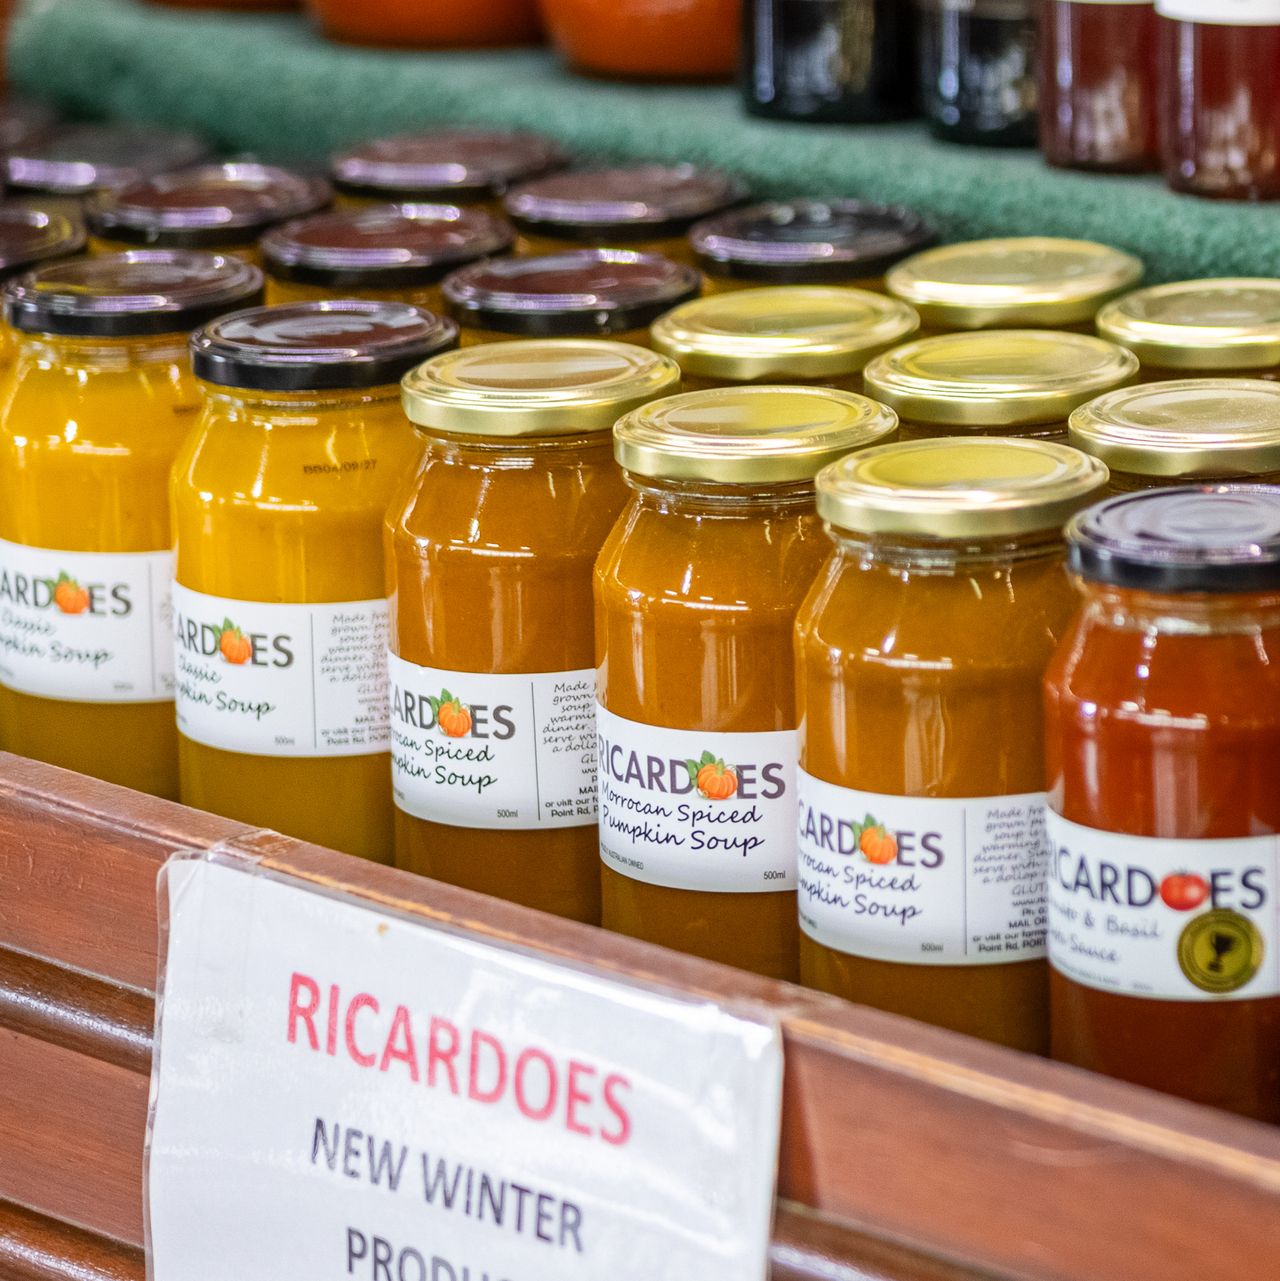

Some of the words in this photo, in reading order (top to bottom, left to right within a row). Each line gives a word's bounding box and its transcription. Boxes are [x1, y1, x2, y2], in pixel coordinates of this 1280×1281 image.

[50, 643, 116, 668] Soup
[554, 681, 590, 693] Made
[215, 691, 277, 720] Soup
[553, 693, 594, 706] grown
[561, 702, 593, 712] soup
[550, 713, 597, 724] warmi
[543, 734, 575, 745] serve
[424, 739, 496, 764] Spiced
[565, 741, 598, 753] dollo
[434, 764, 498, 795] Soup
[545, 800, 554, 809] or
[575, 797, 590, 806] our
[602, 781, 672, 818] Morrocan
[677, 804, 763, 828] Spiced
[497, 808, 519, 819] 500ml
[551, 808, 574, 818] Point
[987, 808, 1023, 820] Made
[602, 804, 685, 846] Pumpkin
[690, 829, 766, 857] Soup
[763, 870, 786, 881] 500ml
[843, 864, 921, 892] Spiced
[854, 893, 923, 926] Soup
[286, 971, 634, 1147] RICARDOES
[311, 1118, 408, 1191] NEW
[422, 1152, 585, 1253] WINTER
